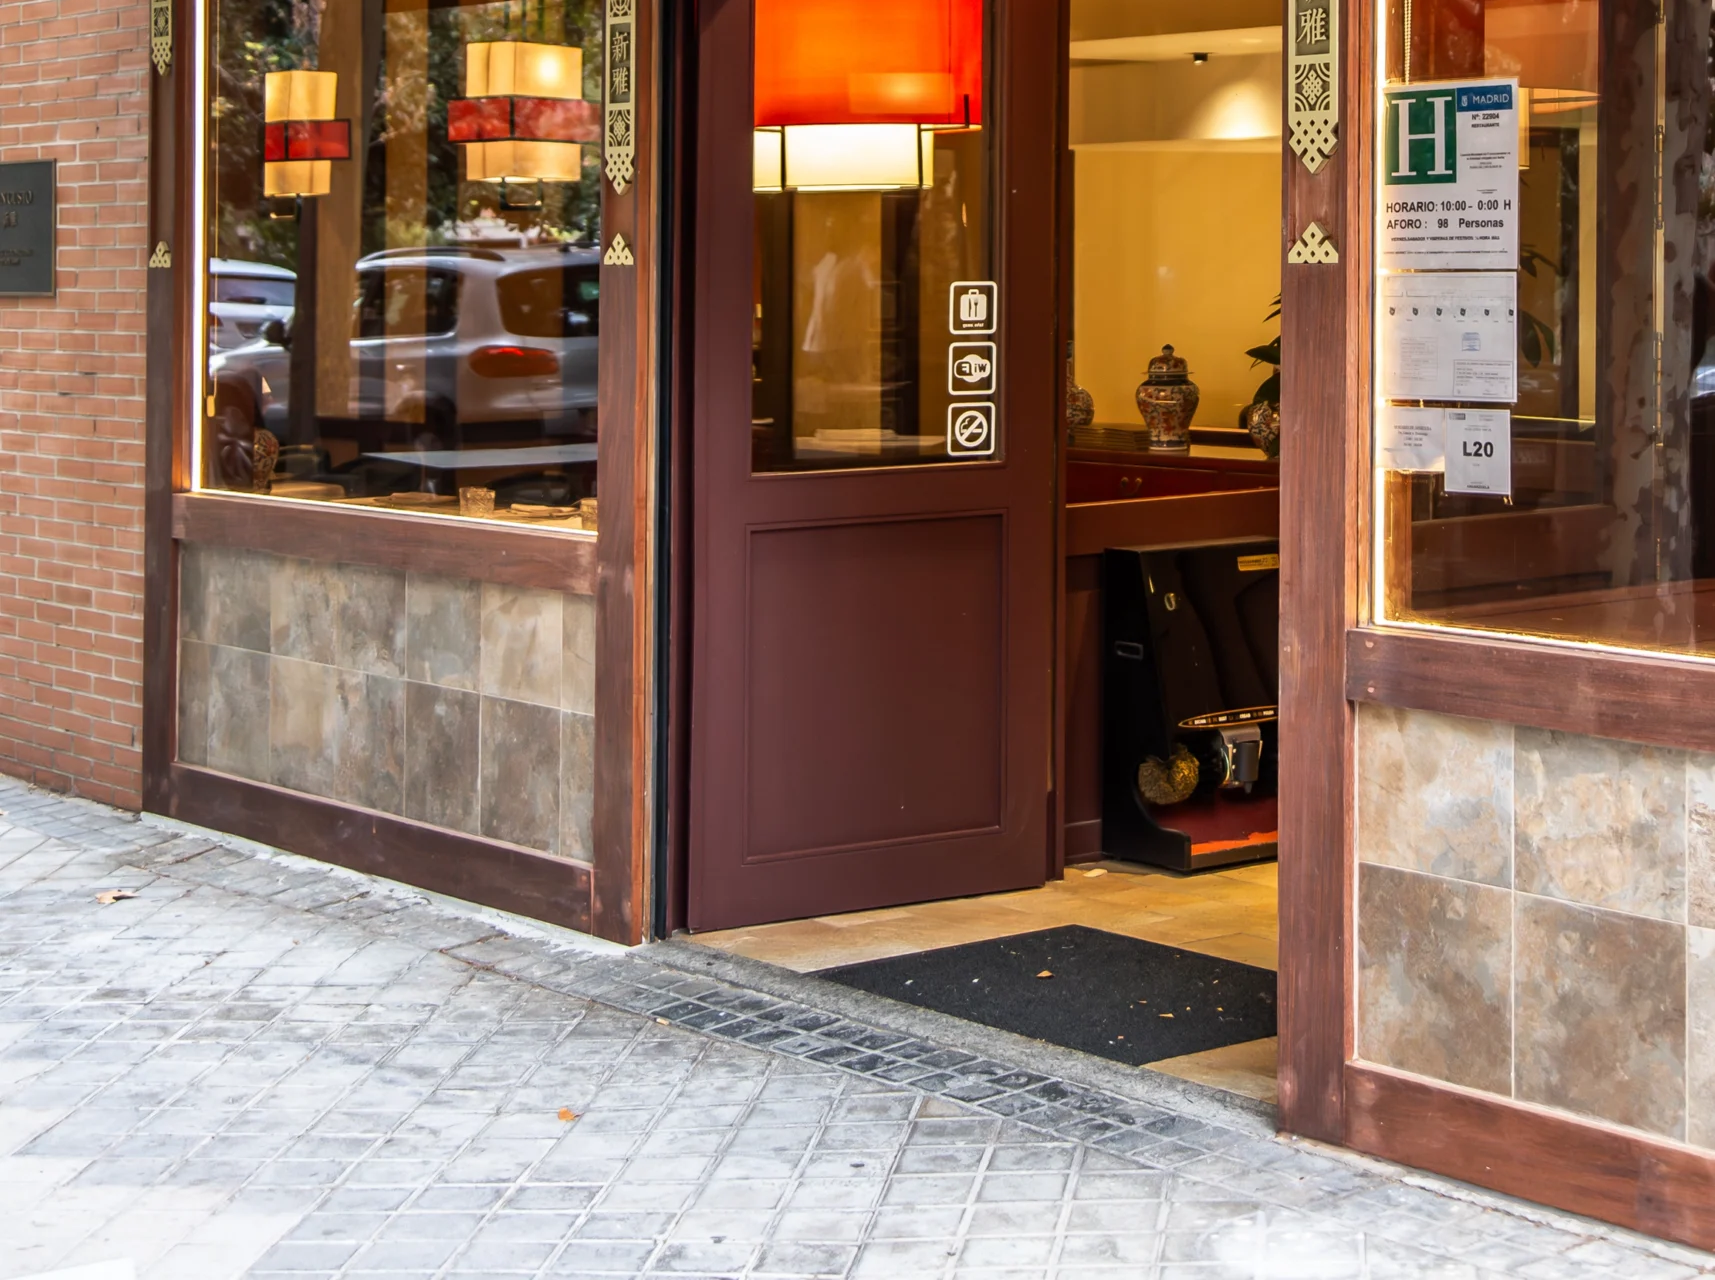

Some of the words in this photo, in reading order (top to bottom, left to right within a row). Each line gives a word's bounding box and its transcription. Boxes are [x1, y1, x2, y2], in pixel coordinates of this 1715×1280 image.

[1472, 93, 1509, 105] MADRID
[1391, 96, 1453, 177] H
[1386, 201, 1438, 213] HORARIO:
[1440, 200, 1466, 211] 10:00
[1477, 199, 1499, 211] 0:00
[1503, 199, 1511, 210] H
[1437, 218, 1449, 229] 98
[1458, 217, 1504, 228] Personas
[1463, 441, 1494, 457] L20
